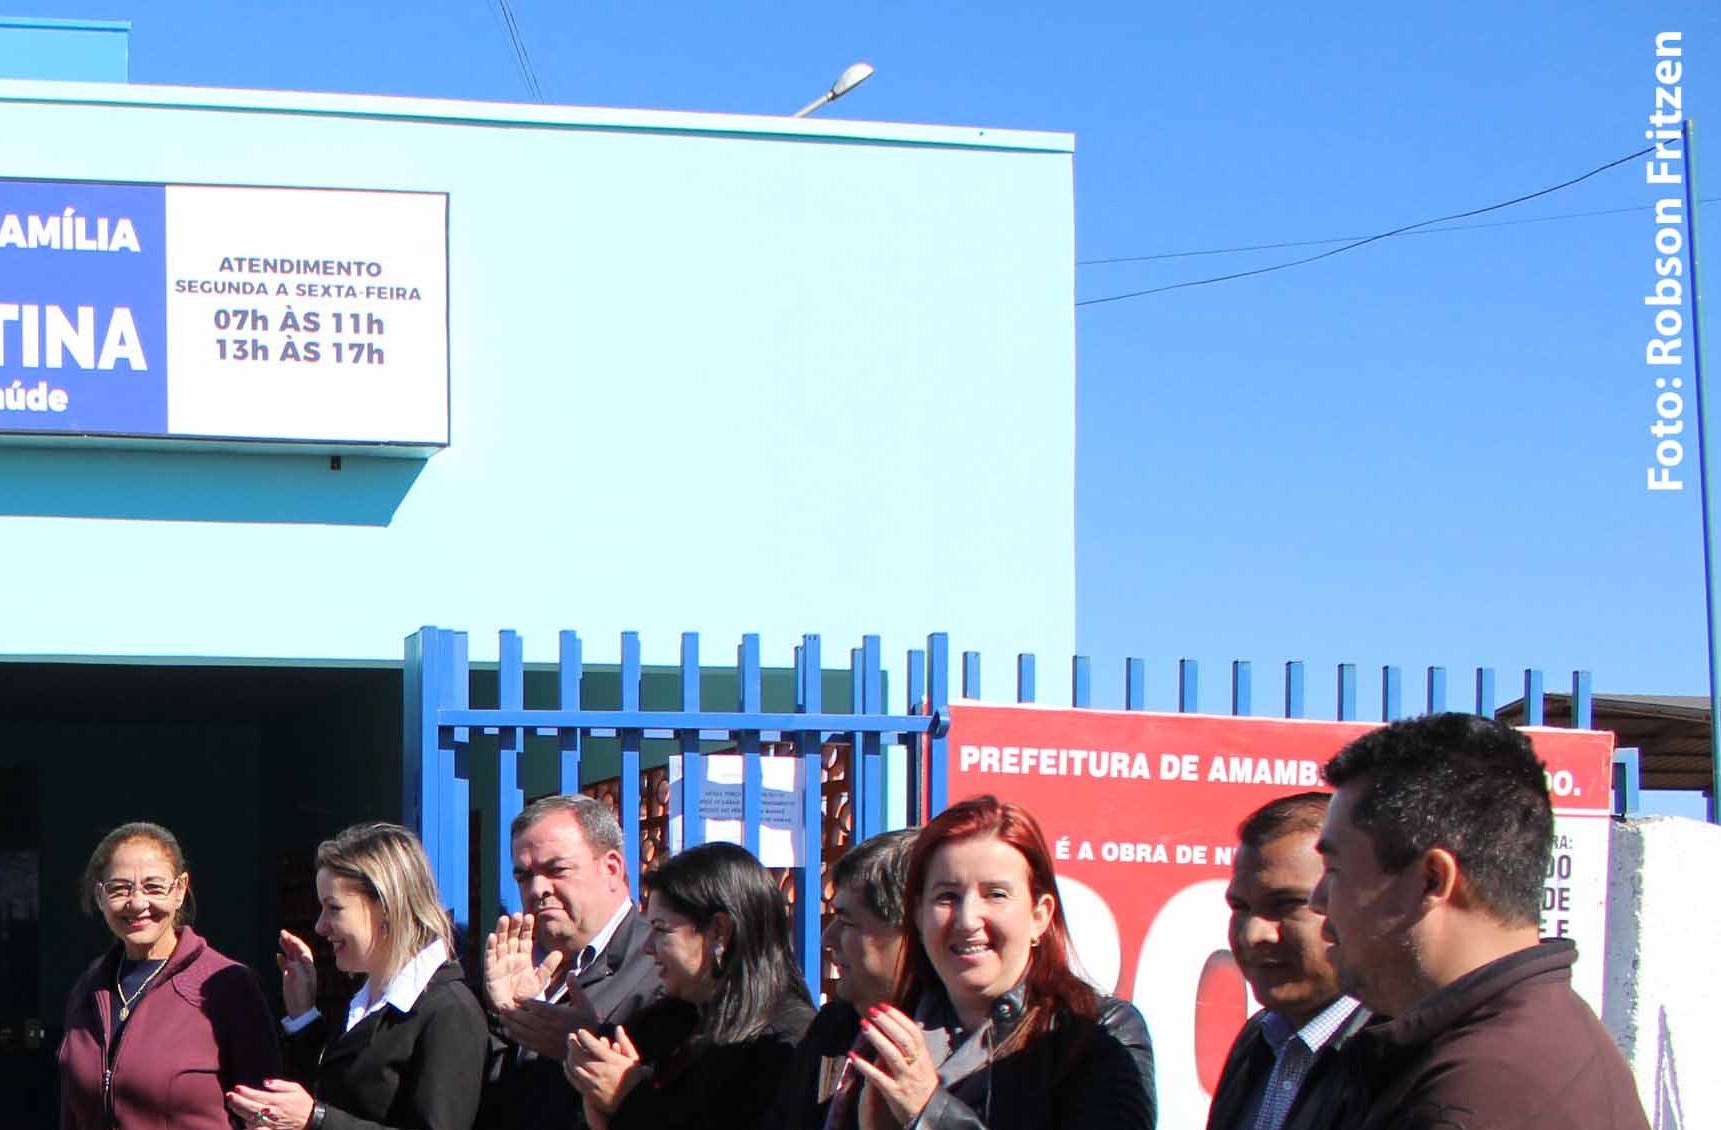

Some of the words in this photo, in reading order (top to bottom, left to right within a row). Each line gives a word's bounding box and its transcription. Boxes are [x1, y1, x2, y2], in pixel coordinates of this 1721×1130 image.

[218, 256, 383, 278] ATENDIMENTO
[174, 279, 269, 296] SEGUNDA
[275, 282, 289, 297] A
[295, 283, 422, 301] SEXTA-FEIRA
[213, 308, 269, 332] 07h
[279, 304, 321, 334] ÀS
[331, 312, 385, 336] 11h
[215, 338, 270, 362] 13h
[279, 335, 322, 363] ÀS
[331, 341, 385, 366] 17h
[959, 745, 1151, 780] PREFEITURA
[1159, 753, 1200, 781] DE
[1207, 756, 1324, 788] AMAMB
[1055, 835, 1071, 860] É
[1076, 840, 1095, 861] A
[1101, 841, 1169, 865] OBRA
[1175, 844, 1208, 866] DE
